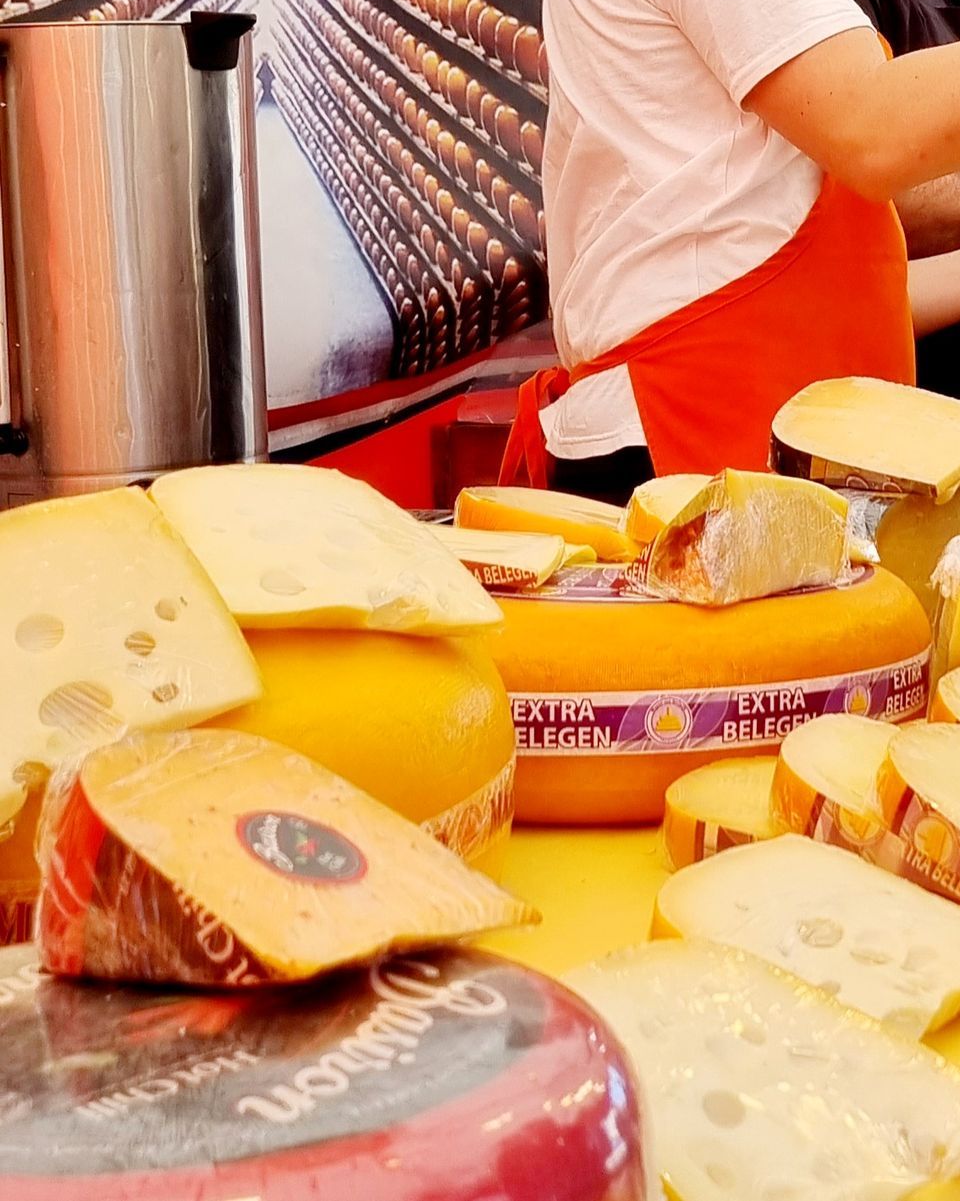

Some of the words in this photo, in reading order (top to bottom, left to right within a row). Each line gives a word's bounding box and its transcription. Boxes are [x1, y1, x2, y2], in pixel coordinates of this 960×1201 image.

[892, 660, 923, 691] EXTRA
[513, 698, 597, 723] EXTRA
[737, 687, 807, 716] EXTRA
[515, 726, 612, 749] ELEGEN
